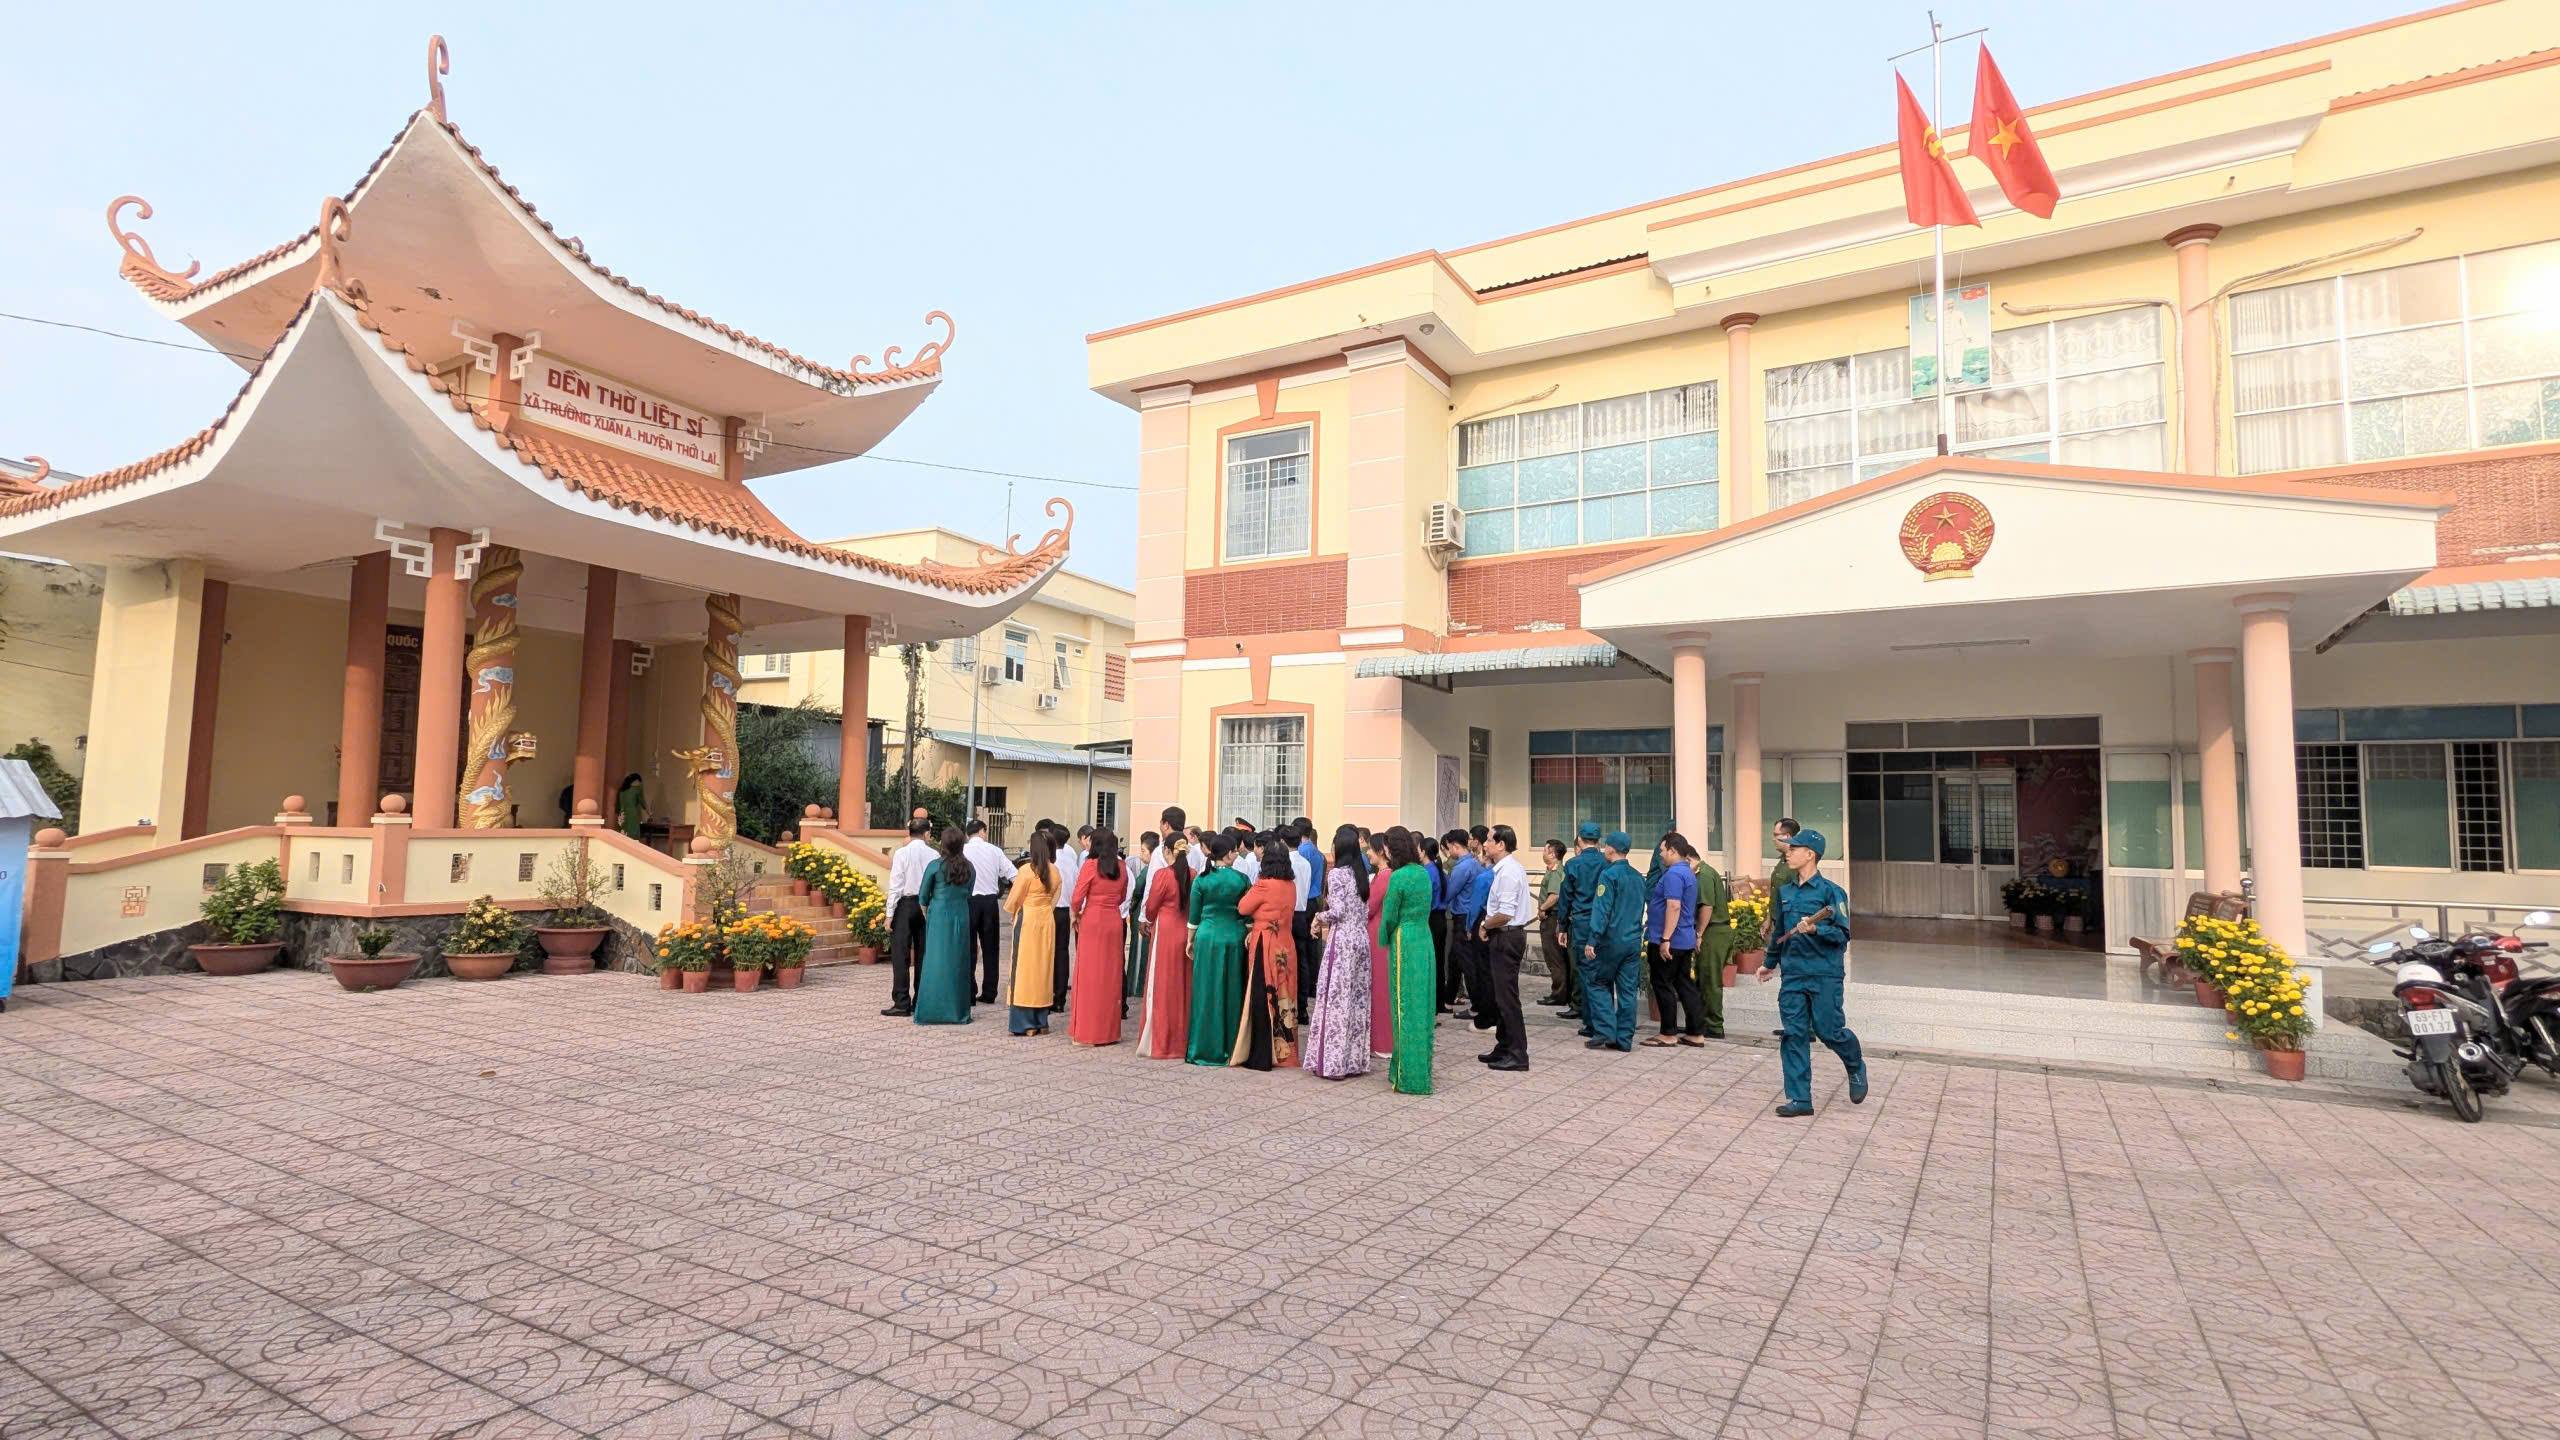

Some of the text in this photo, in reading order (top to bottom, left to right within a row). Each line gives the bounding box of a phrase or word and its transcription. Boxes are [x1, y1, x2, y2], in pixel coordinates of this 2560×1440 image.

[523, 392, 540, 410] XÃ
[547, 367, 590, 400] ĐỀN
[597, 385, 638, 415] THỜ
